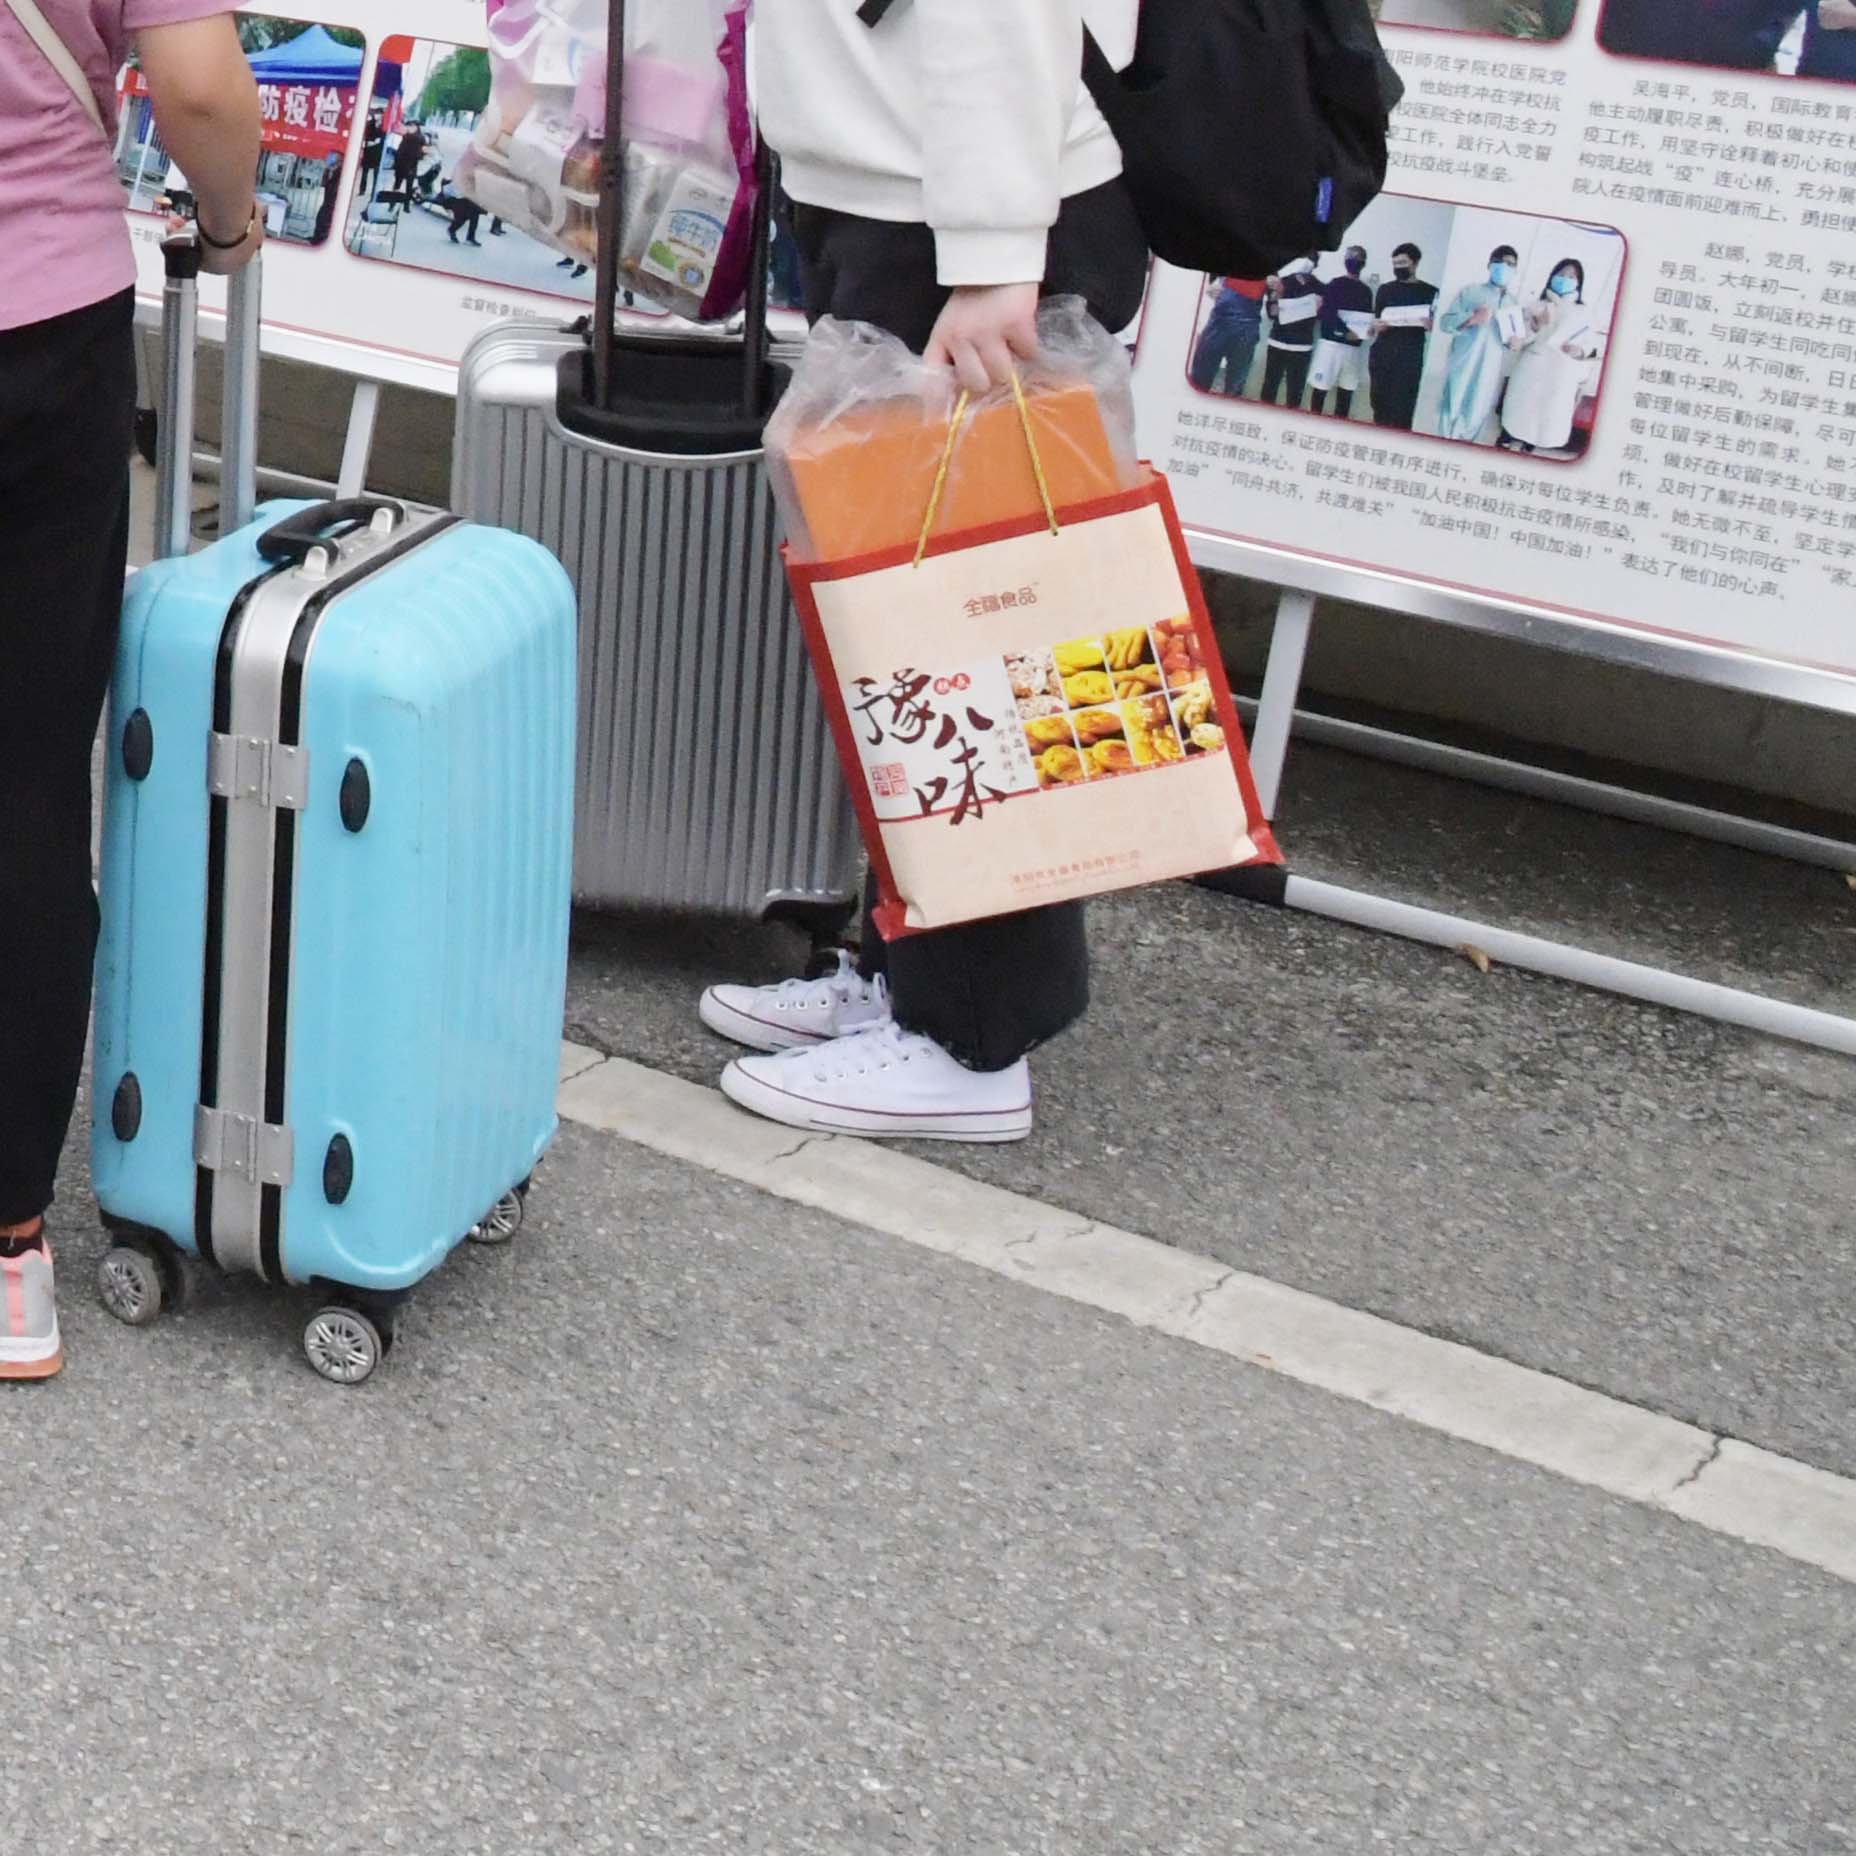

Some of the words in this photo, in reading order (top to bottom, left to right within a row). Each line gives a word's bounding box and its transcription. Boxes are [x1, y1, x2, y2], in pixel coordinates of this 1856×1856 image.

[1632, 79, 1856, 122] 吴海平，党员，国际教育
[1648, 313, 1856, 364] 公寓，与留学生同吃同
